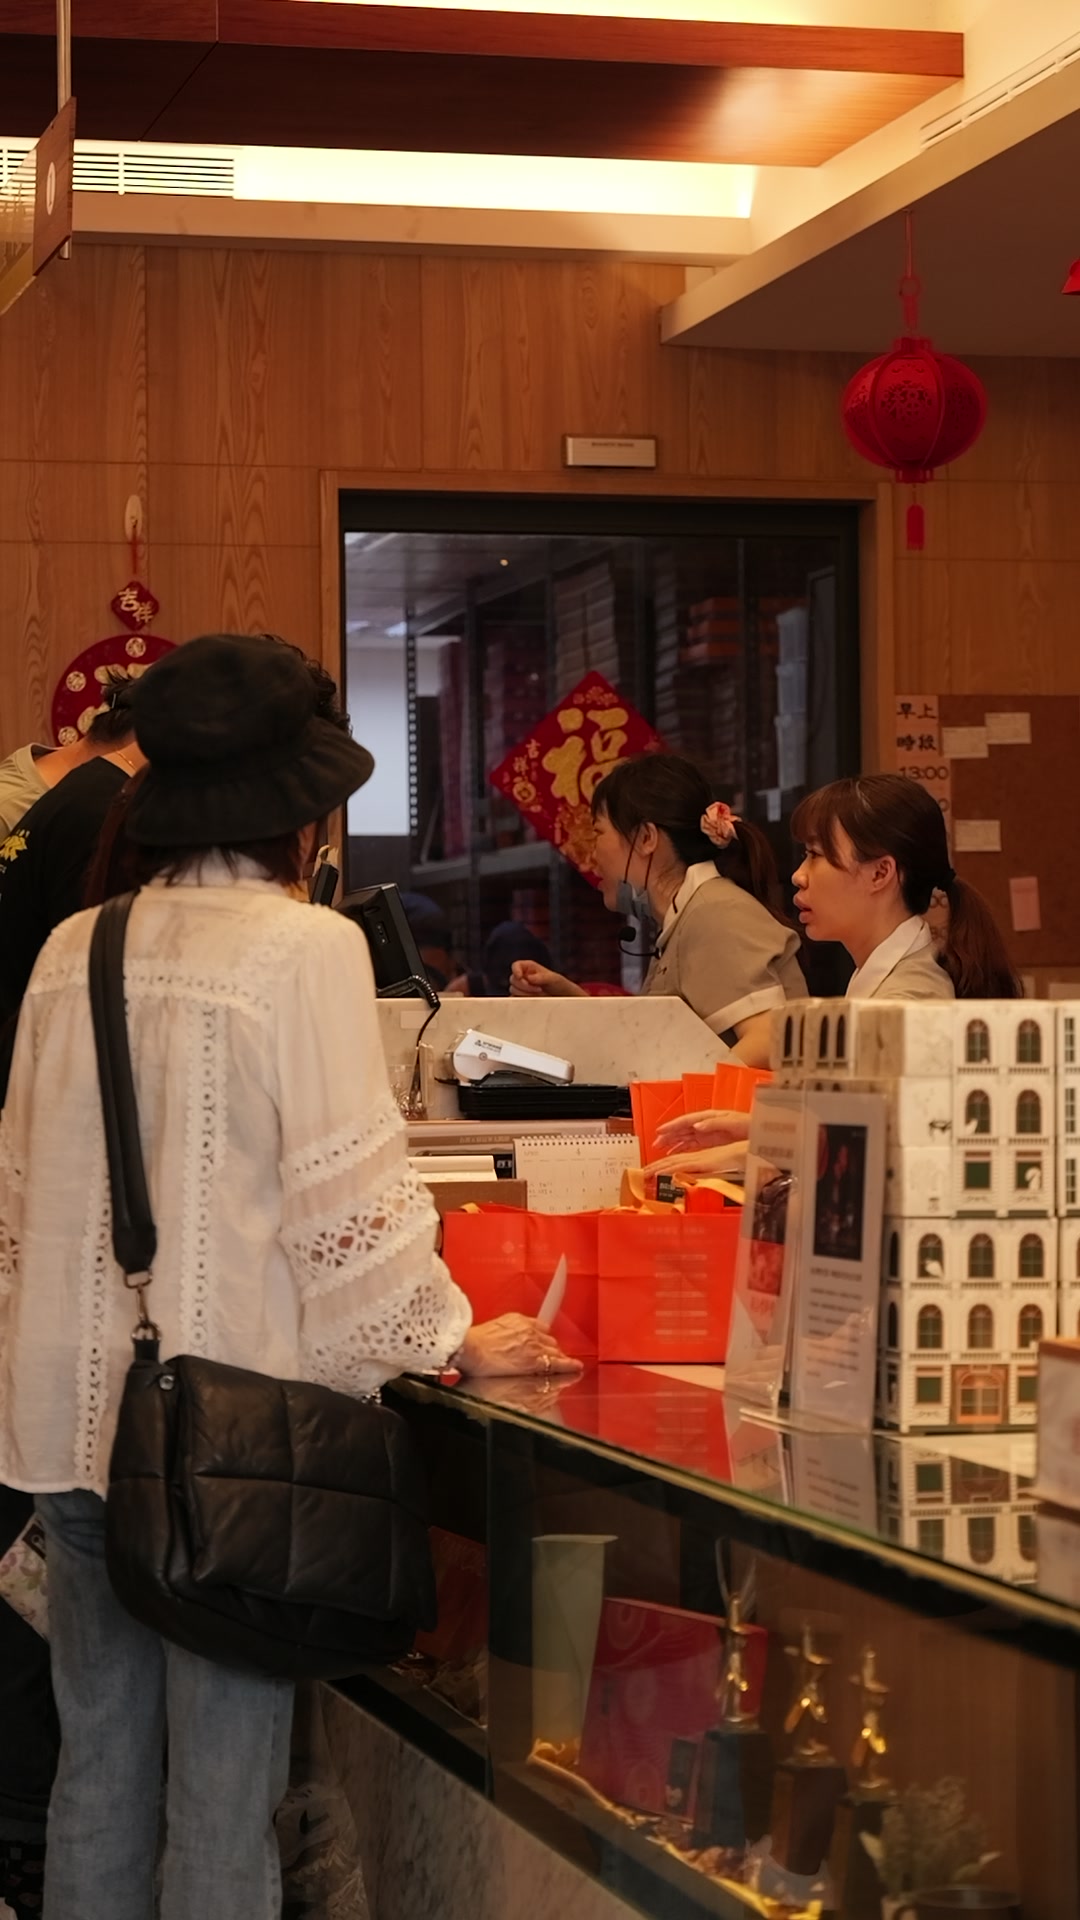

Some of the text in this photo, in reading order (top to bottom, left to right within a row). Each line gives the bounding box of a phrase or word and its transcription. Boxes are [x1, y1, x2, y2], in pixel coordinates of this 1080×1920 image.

[118, 588, 153, 623] 吉祥
[896, 703, 937, 719] 早上
[896, 734, 937, 751] 時段
[512, 738, 542, 777] 吉祥
[541, 707, 629, 807] 福
[899, 766, 949, 780] 13:00
